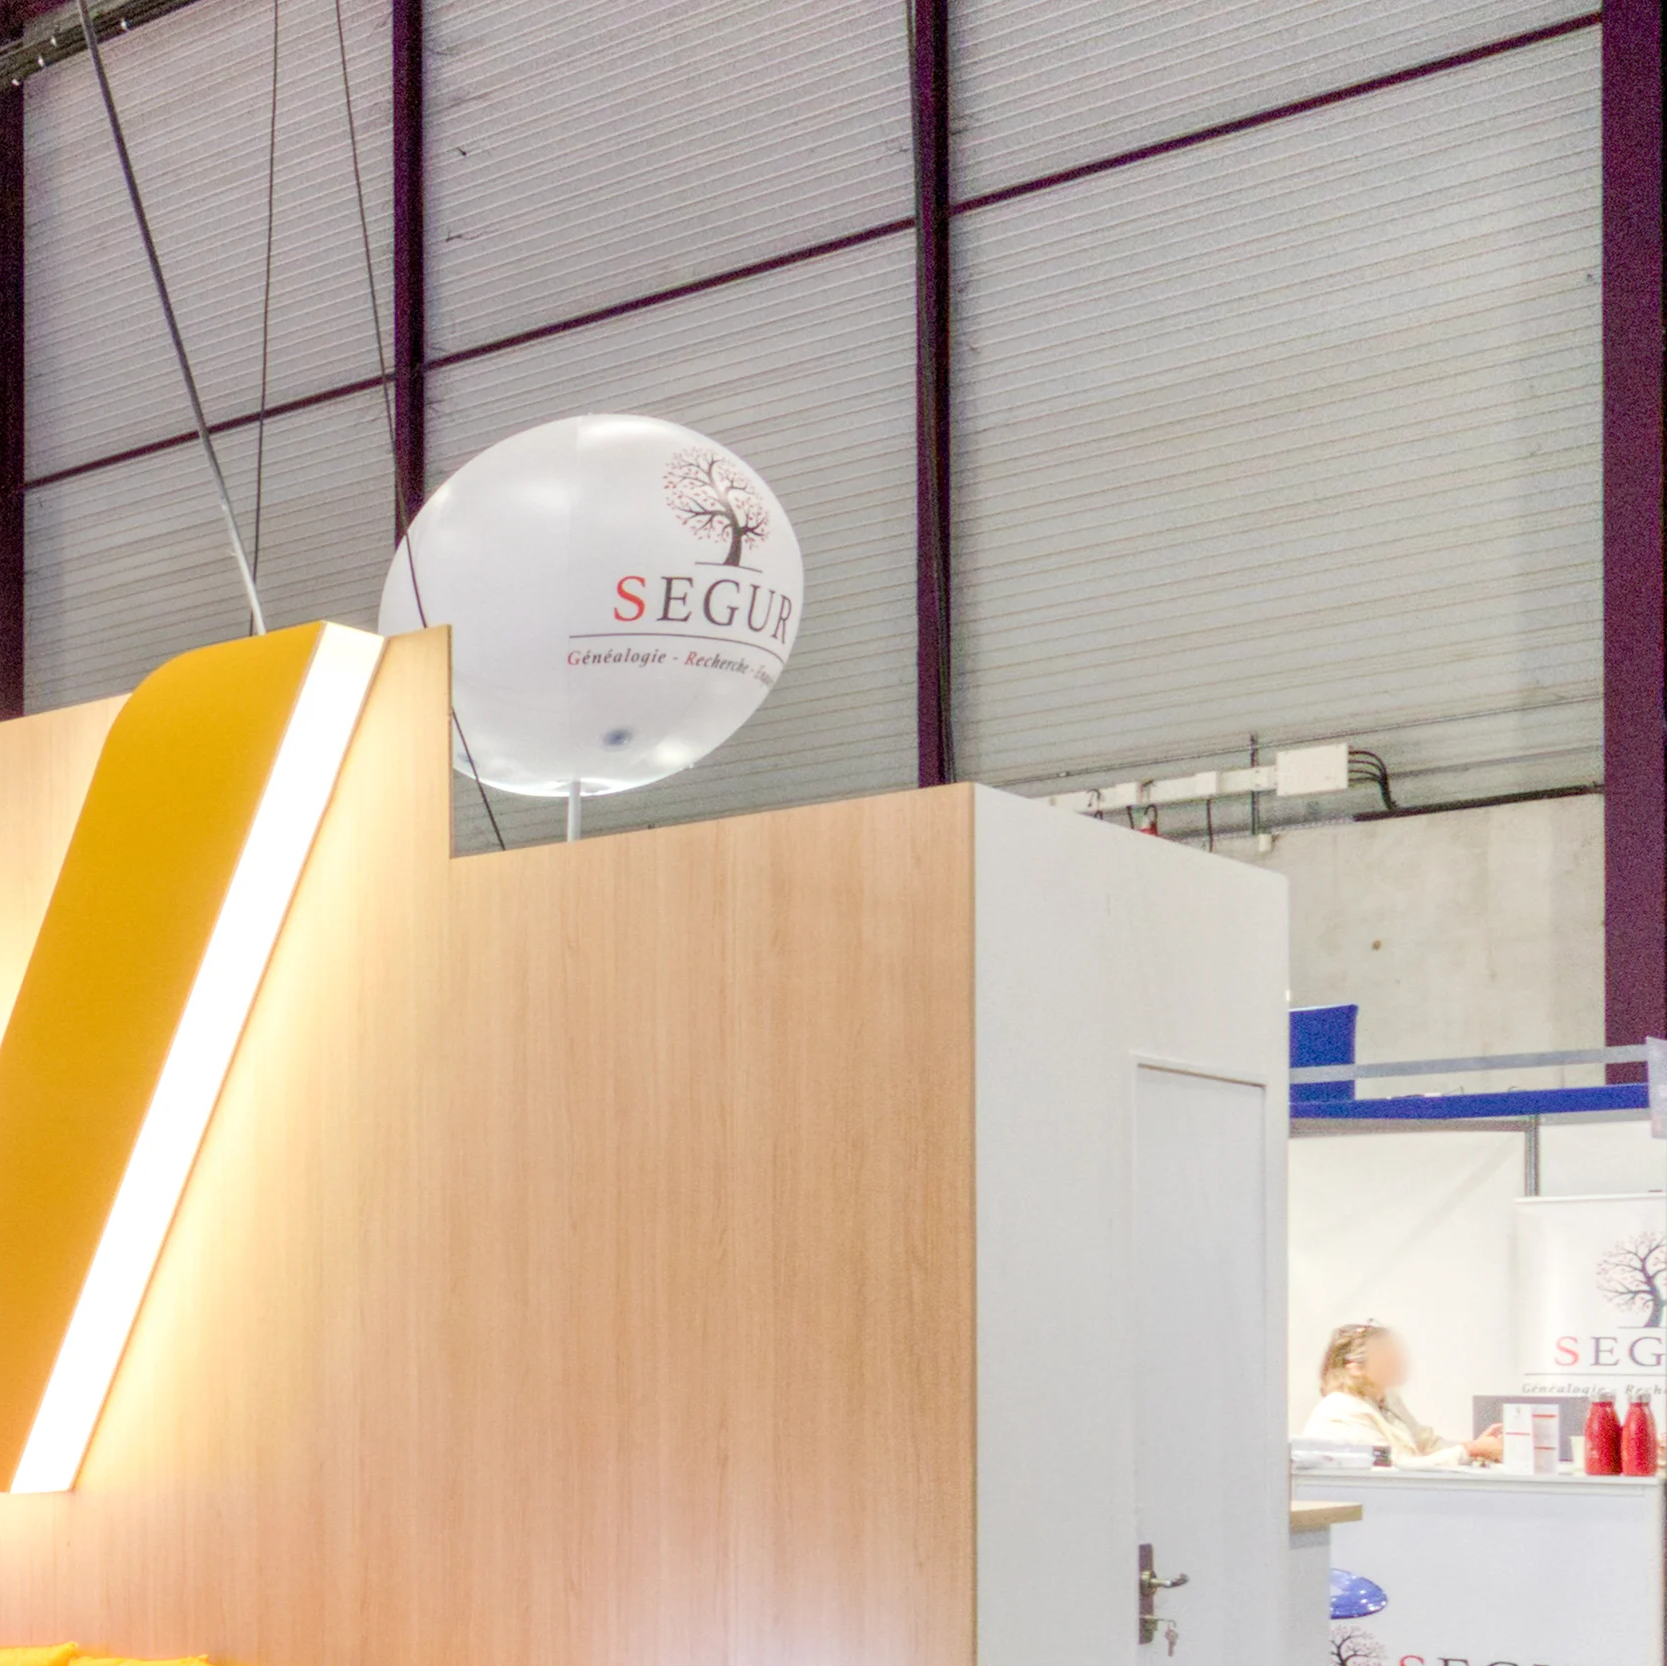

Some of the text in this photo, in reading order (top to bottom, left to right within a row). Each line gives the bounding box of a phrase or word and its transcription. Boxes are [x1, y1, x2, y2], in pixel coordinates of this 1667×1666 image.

[613, 575, 793, 644] SEGUR
[567, 648, 667, 671] Généalogie
[684, 650, 748, 675] Recherche
